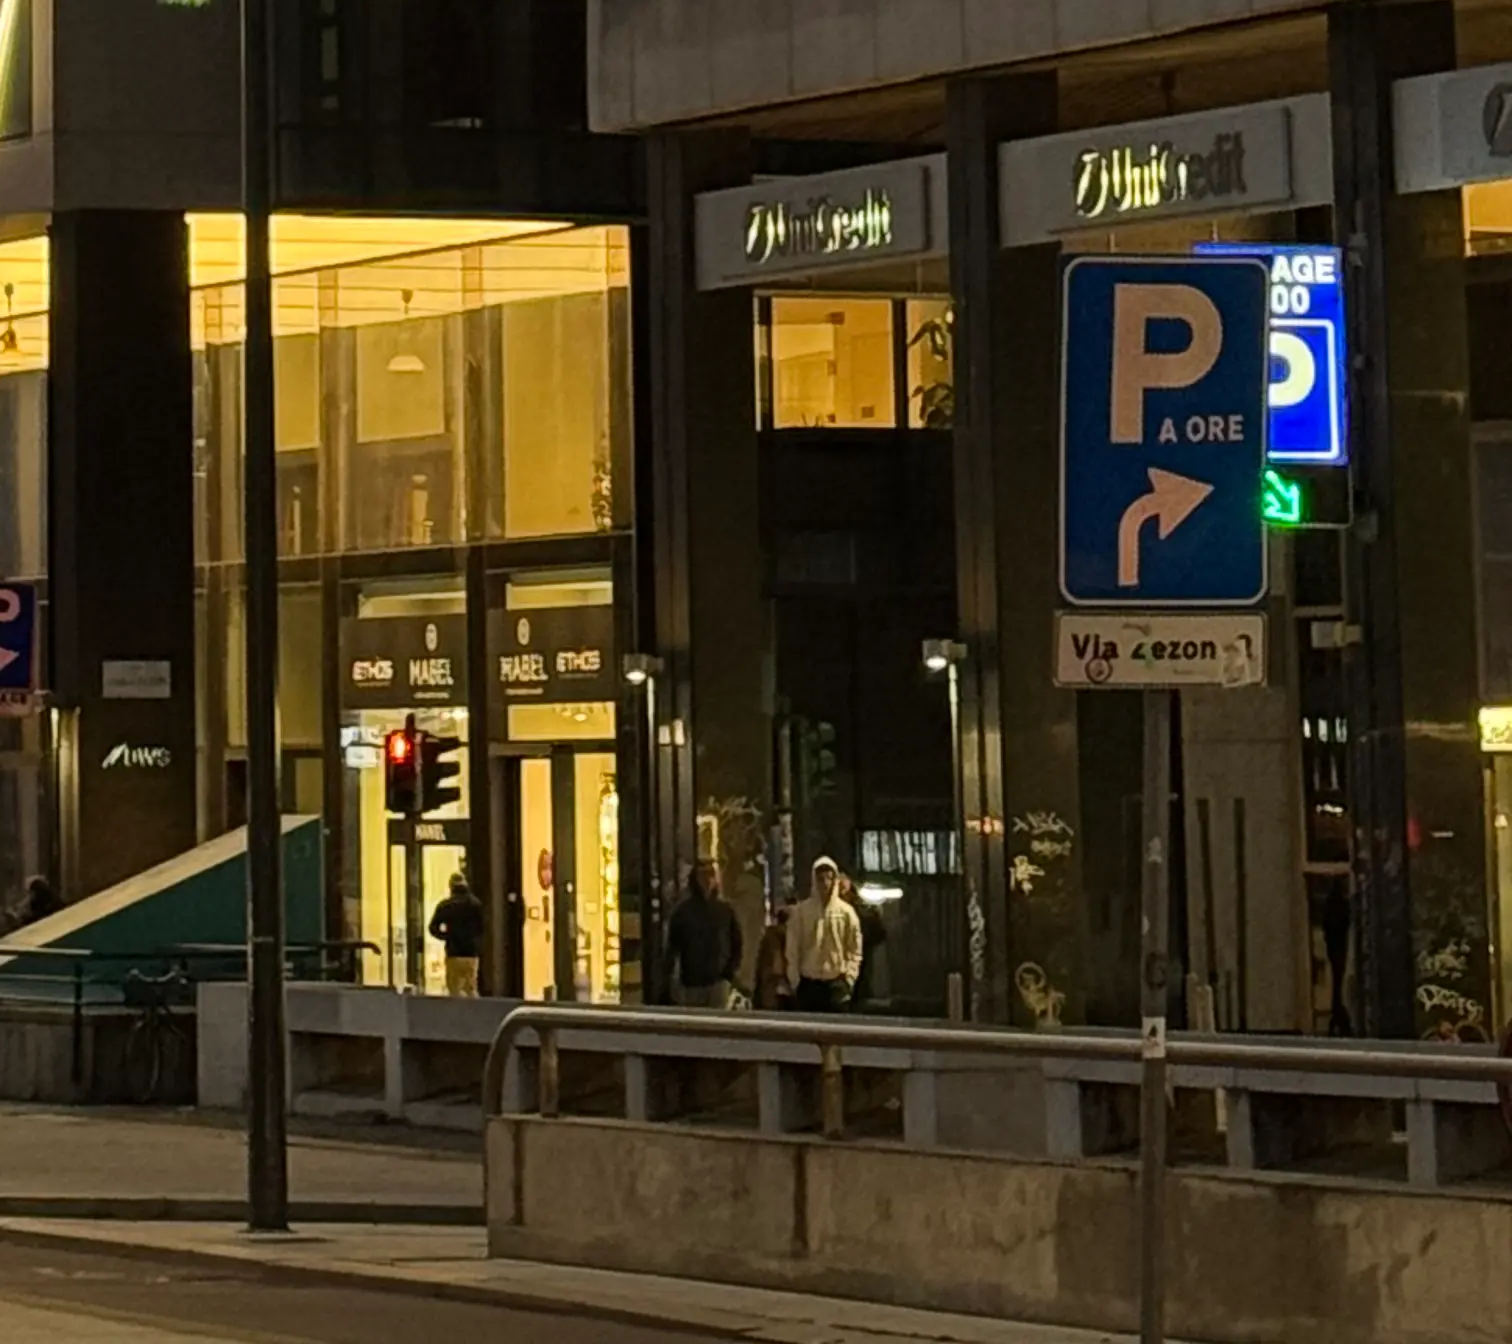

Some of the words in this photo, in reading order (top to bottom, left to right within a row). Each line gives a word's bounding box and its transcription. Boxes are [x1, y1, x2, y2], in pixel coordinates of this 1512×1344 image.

[1270, 255, 1337, 284] AGE
[1110, 283, 1223, 444] P
[1157, 417, 1178, 444] A
[1185, 414, 1245, 443] ORE
[1071, 633, 1120, 661] Via
